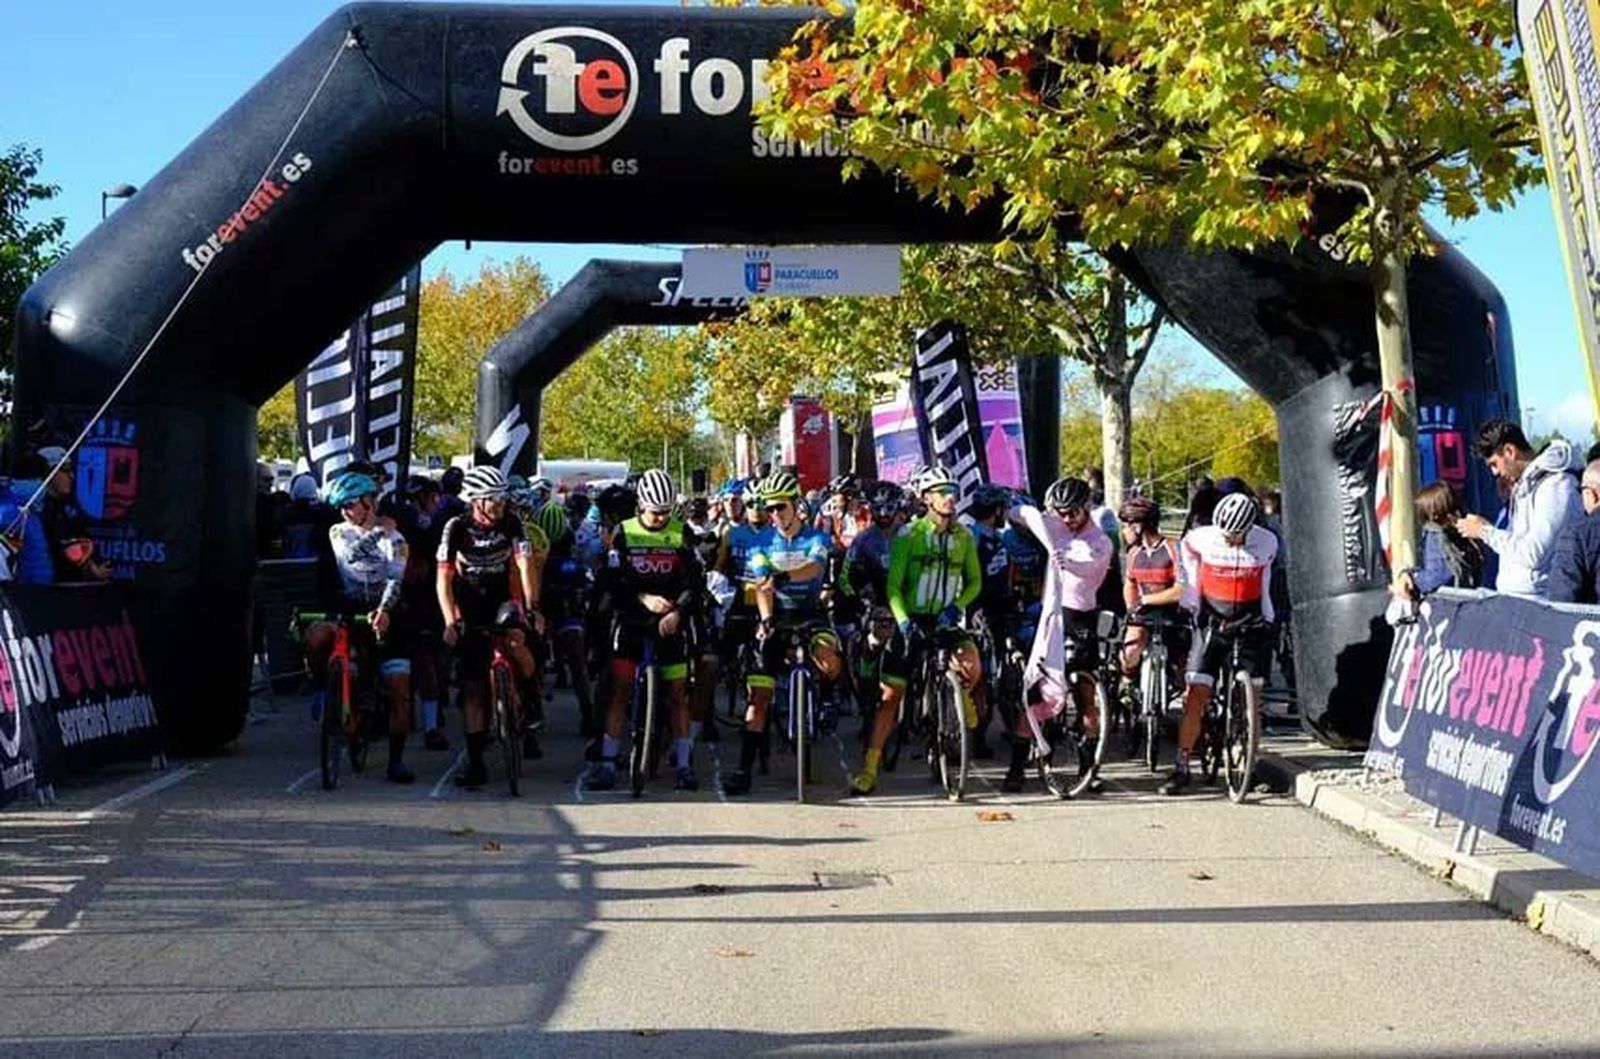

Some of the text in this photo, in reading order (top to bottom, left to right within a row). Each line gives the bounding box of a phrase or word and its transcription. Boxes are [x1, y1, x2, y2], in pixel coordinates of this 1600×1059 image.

[181, 152, 313, 272] forevent.es
[498, 155, 639, 176] forevent.es
[774, 268, 839, 280] PARACUELLOS
[3, 609, 147, 706] forevent
[1417, 618, 1546, 738] forevent
